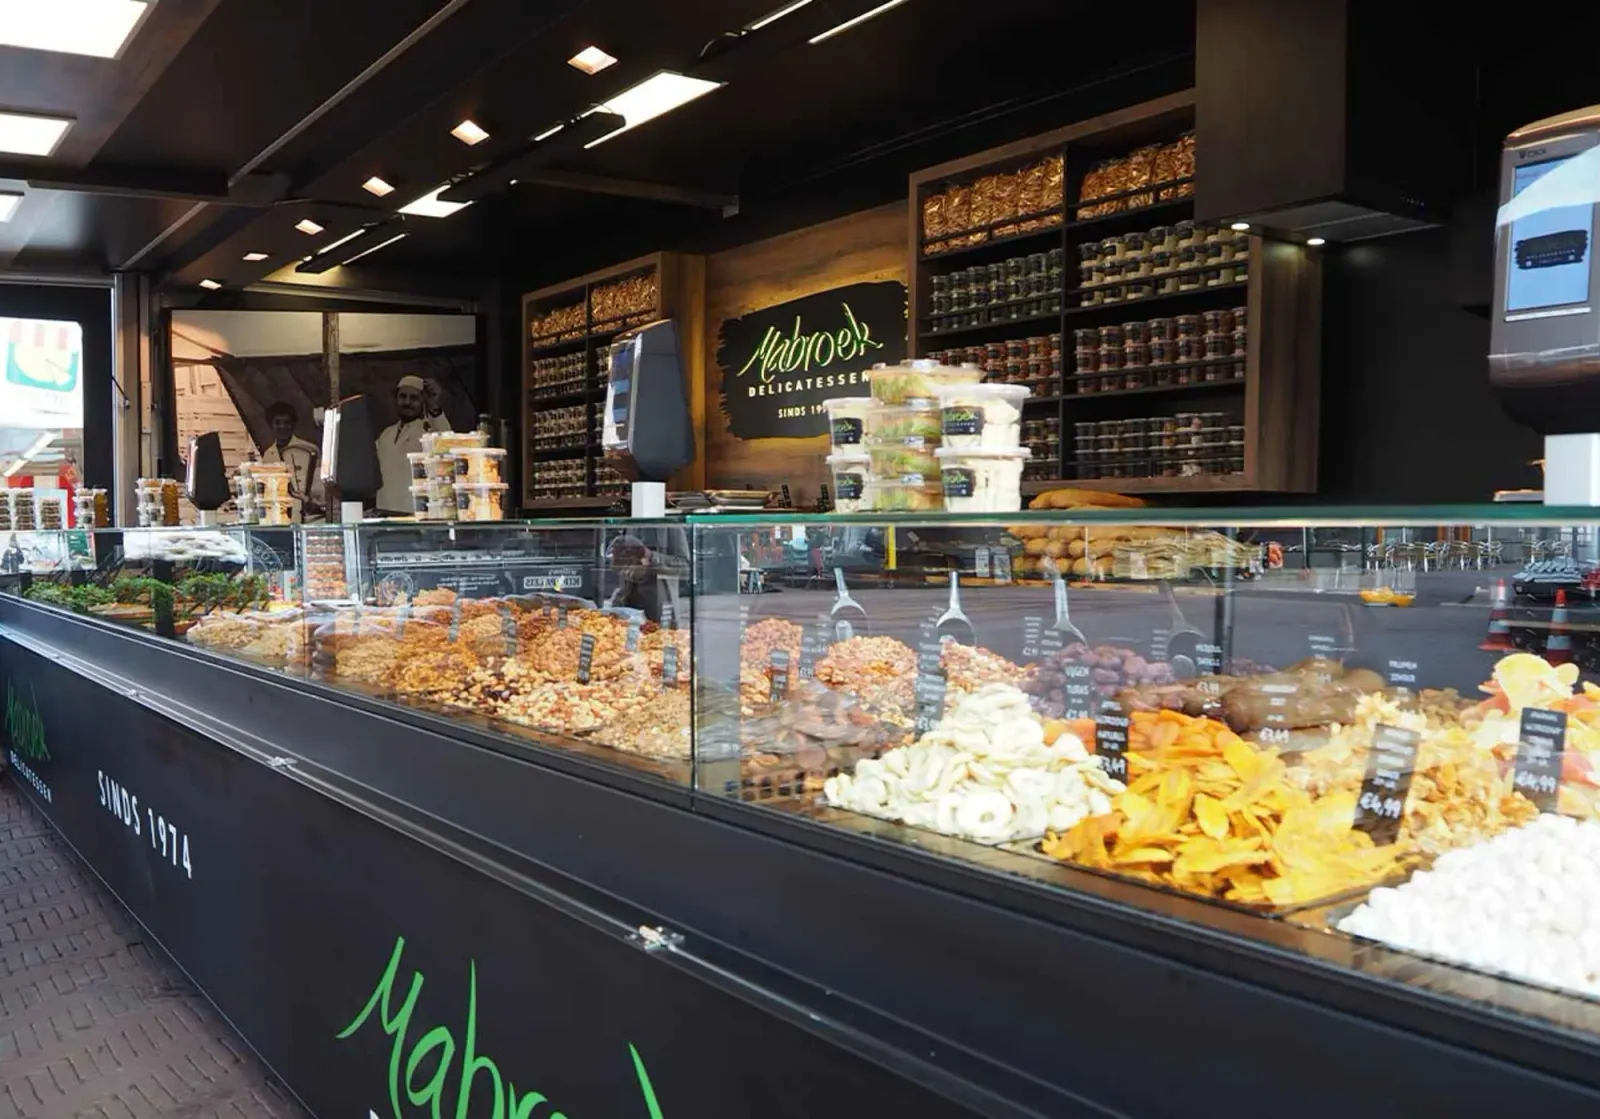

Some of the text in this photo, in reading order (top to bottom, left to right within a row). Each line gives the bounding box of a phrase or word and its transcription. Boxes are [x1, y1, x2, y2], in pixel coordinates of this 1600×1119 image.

[736, 302, 884, 384] Mabroek
[778, 406, 806, 418] SINDS
[97, 769, 192, 880] SINDS 1974
